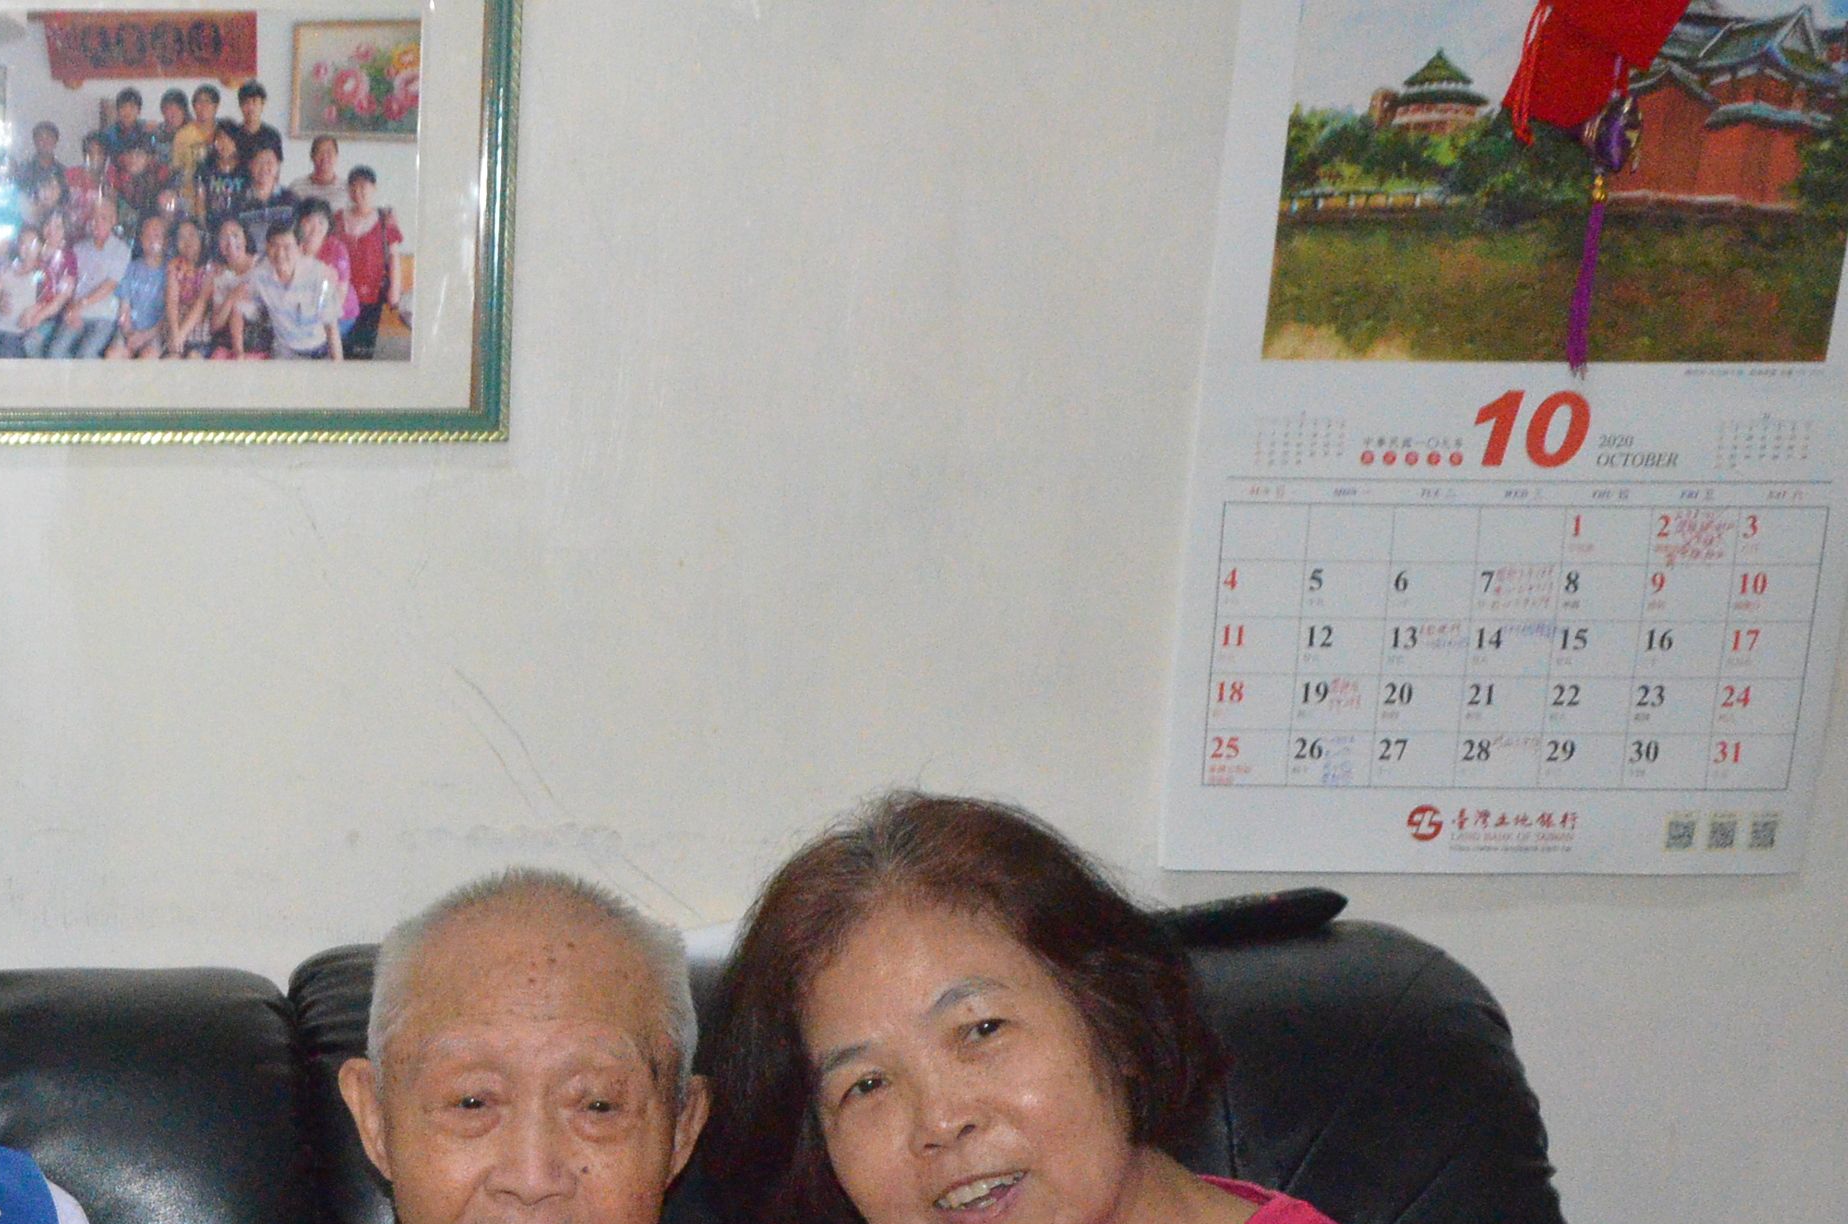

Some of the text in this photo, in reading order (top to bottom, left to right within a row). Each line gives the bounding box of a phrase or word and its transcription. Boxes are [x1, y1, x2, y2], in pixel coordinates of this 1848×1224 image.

[1474, 389, 1591, 468] 10
[1599, 435, 1635, 448] 2020
[1596, 451, 1678, 468] OCTOBER
[1572, 514, 1582, 537] 1
[1657, 514, 1673, 539] 2
[1743, 514, 1759, 539] 3
[1223, 568, 1237, 590] 4
[1309, 568, 1324, 591] 5
[1394, 571, 1408, 591] 6
[1481, 571, 1494, 592] 7
[1564, 572, 1580, 593] 8
[1651, 573, 1667, 594] 9
[1740, 573, 1768, 594] 10
[1223, 625, 1244, 647] 11
[1308, 625, 1333, 648] 12
[1392, 626, 1418, 648] 13
[1477, 628, 1502, 649] 14
[1561, 628, 1588, 650] 15
[1647, 629, 1673, 651] 16
[1732, 629, 1760, 651] 17
[1218, 681, 1244, 702] 18
[1302, 682, 1329, 704] 19
[1384, 682, 1413, 705] 20
[1468, 684, 1494, 706] 21
[1552, 684, 1580, 706] 22
[1636, 685, 1665, 707] 23
[1722, 685, 1750, 707] 24
[1211, 736, 1239, 759] 25
[1294, 737, 1323, 759] 26
[1379, 738, 1408, 761] 27
[1463, 739, 1491, 761] 28
[1546, 740, 1576, 762] 29
[1629, 740, 1660, 763] 30
[1713, 741, 1743, 764] 31
